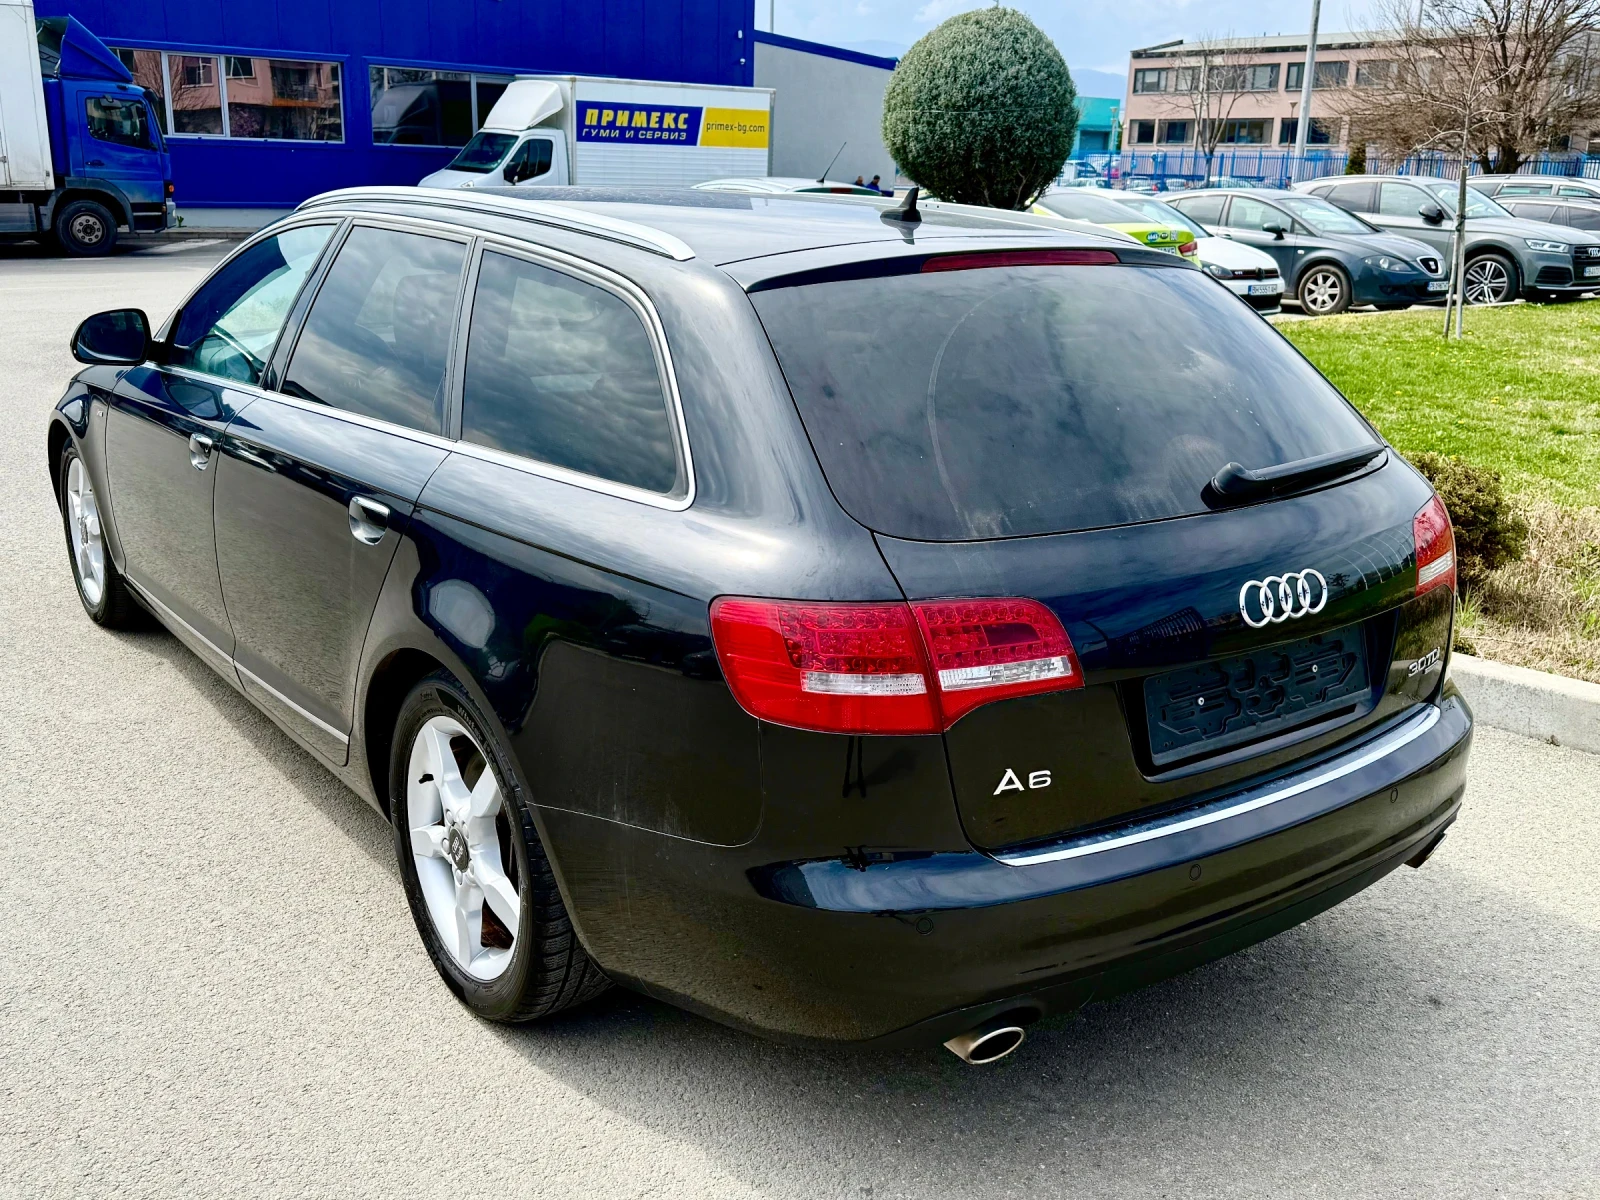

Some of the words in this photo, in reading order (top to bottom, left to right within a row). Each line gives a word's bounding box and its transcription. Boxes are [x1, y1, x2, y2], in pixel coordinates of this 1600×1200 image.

[584, 108, 689, 129] ПРИМЕКС
[582, 128, 620, 138] ГУМИ
[625, 130, 634, 138] И
[638, 130, 687, 140] СЕРВИЗ
[706, 121, 766, 134] primex-bg.com
[993, 768, 1052, 796] A6
